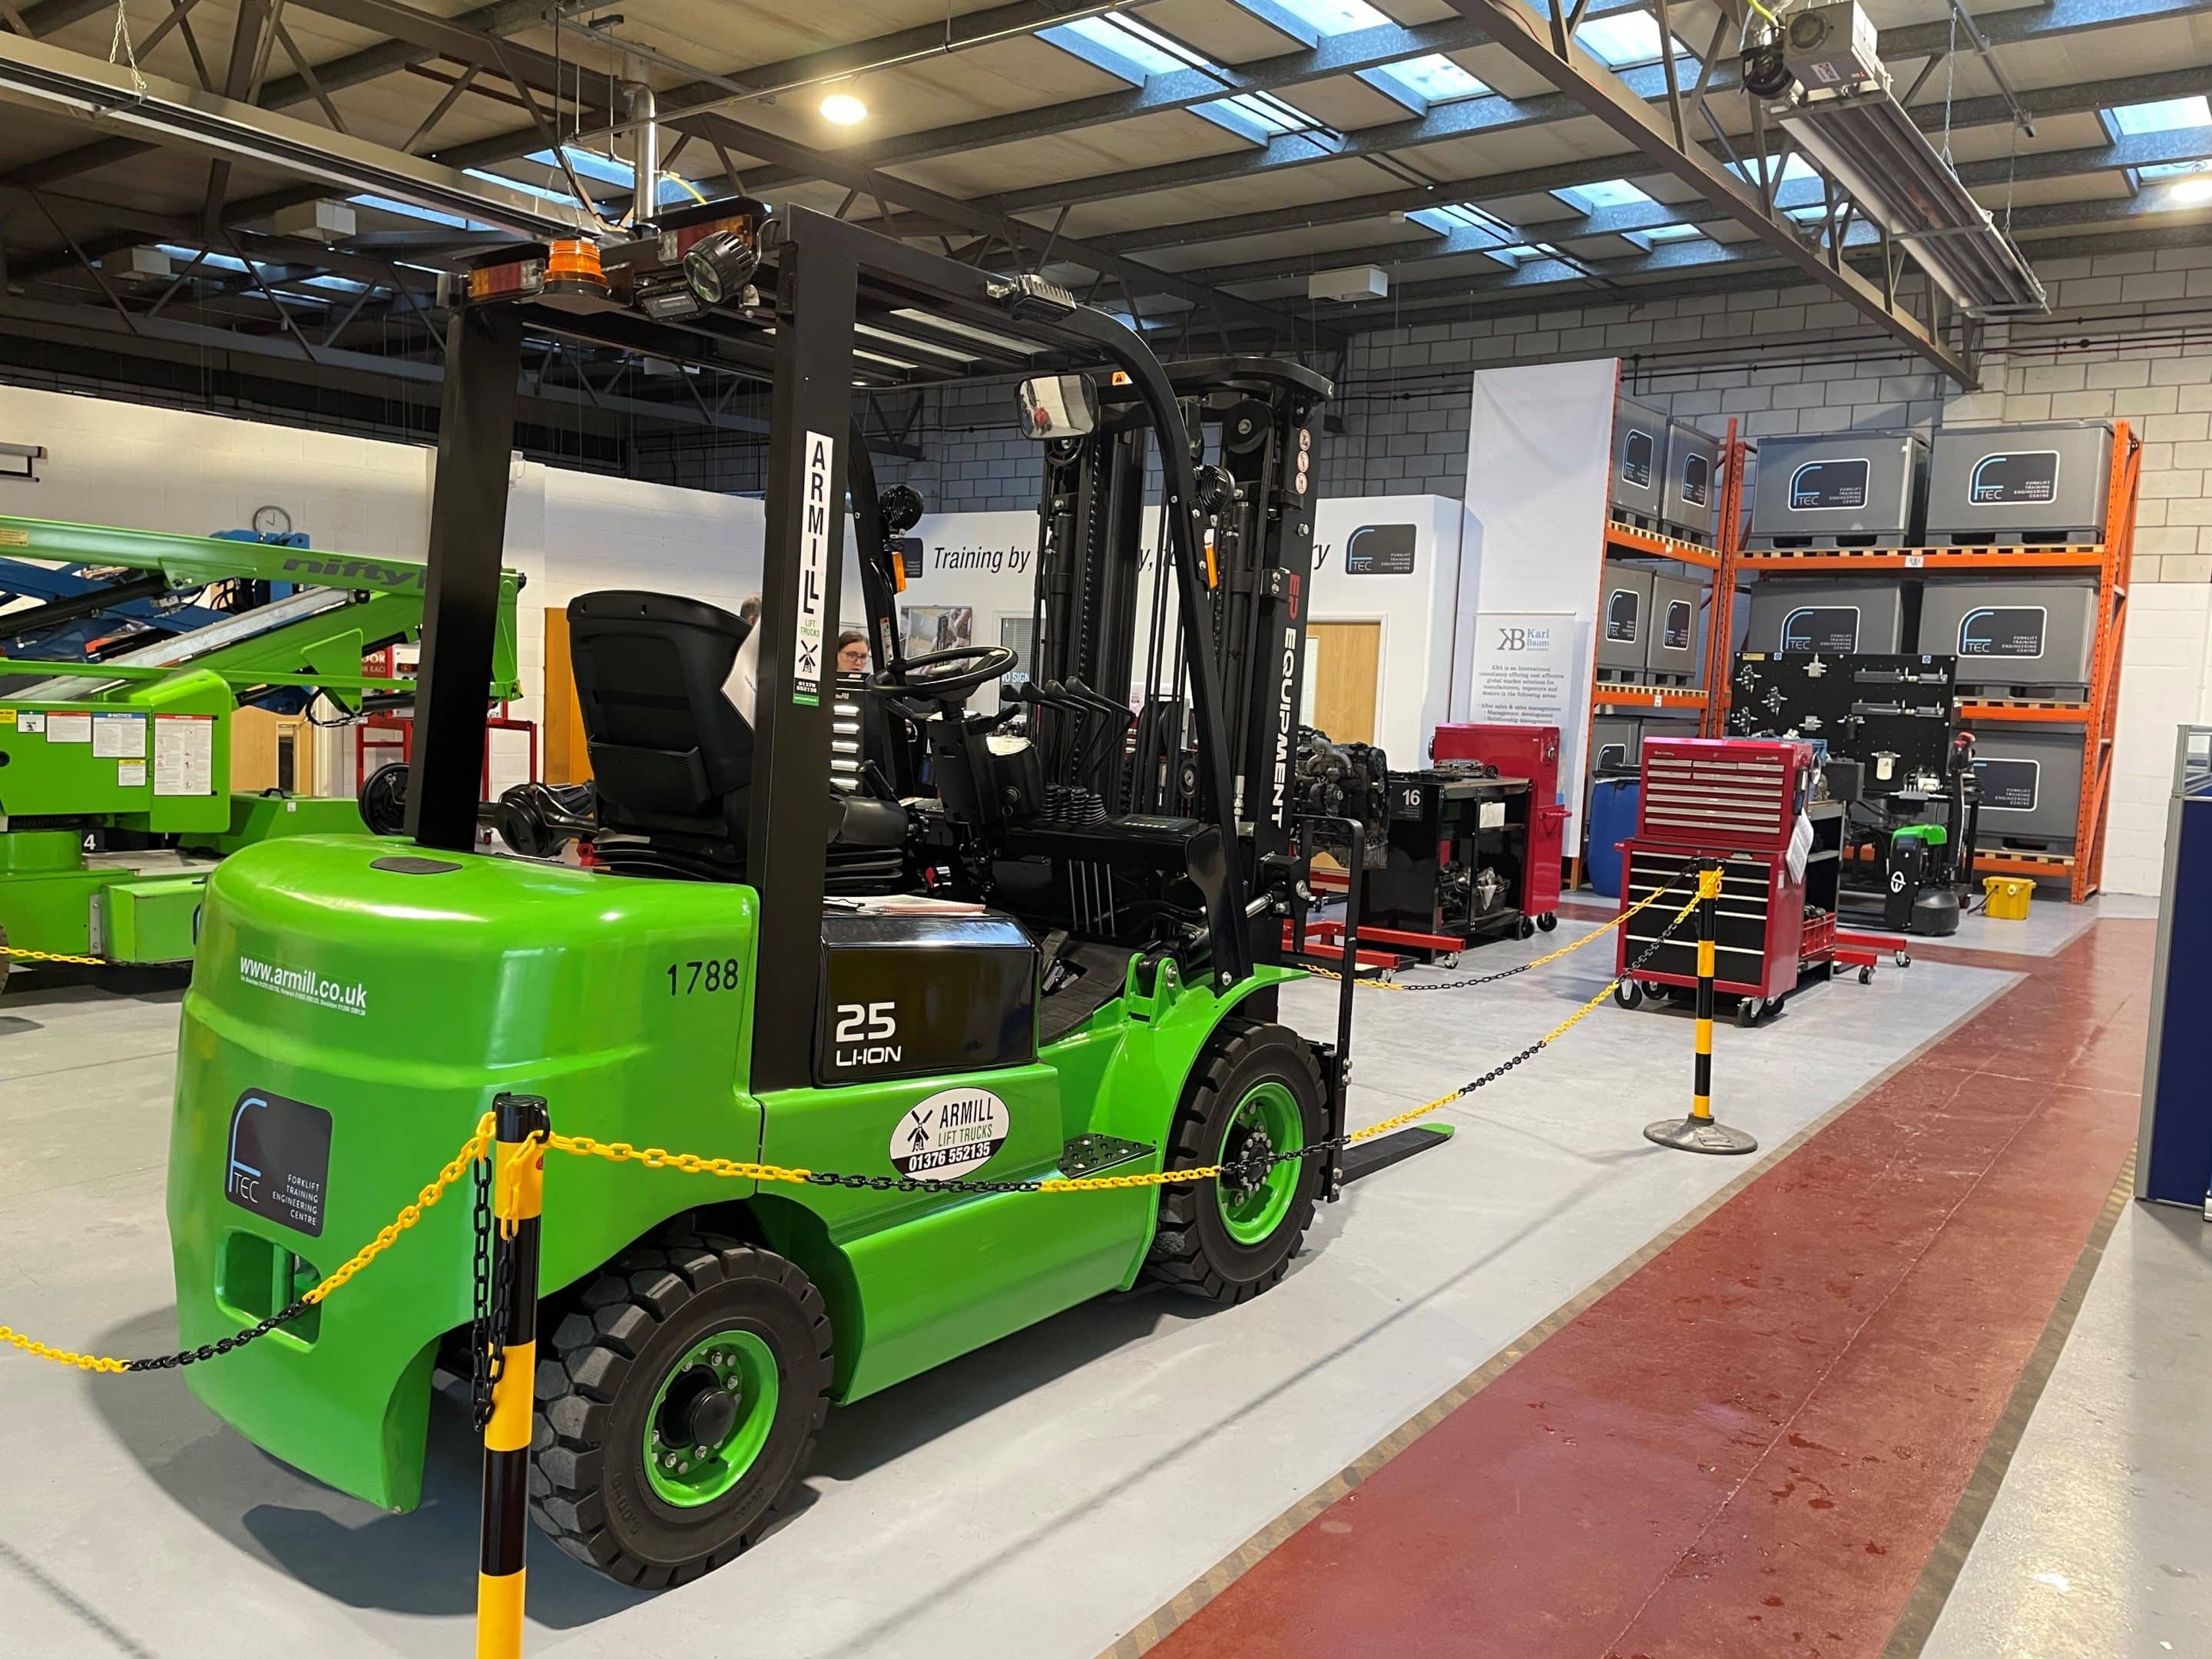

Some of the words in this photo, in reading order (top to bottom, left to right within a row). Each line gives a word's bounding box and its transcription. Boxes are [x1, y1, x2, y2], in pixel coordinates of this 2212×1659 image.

[803, 440, 826, 614] ARMILL
[934, 546, 1003, 573] Training
[1008, 546, 1031, 573] by
[1527, 628, 1549, 638] Karl
[1012, 671, 1030, 683] SIGN
[1271, 627, 1296, 830] EQUIPMENT
[1402, 789, 1421, 806] 16
[84, 834, 96, 850] 4
[240, 956, 367, 1008] www.armill.co.uk
[667, 958, 739, 996] 1788
[836, 1002, 896, 1042] 25
[939, 1098, 994, 1129] ARMILL
[938, 1130, 957, 1147] LIFT
[959, 1124, 993, 1144] TRUCKS
[909, 1151, 946, 1172] 01376
[949, 1141, 991, 1164] 552135
[286, 1184, 319, 1204] TRAINING
[287, 1174, 320, 1191] FORKLIFT
[272, 1191, 318, 1215] ENGINEERING
[290, 1210, 317, 1227] CENTRE
